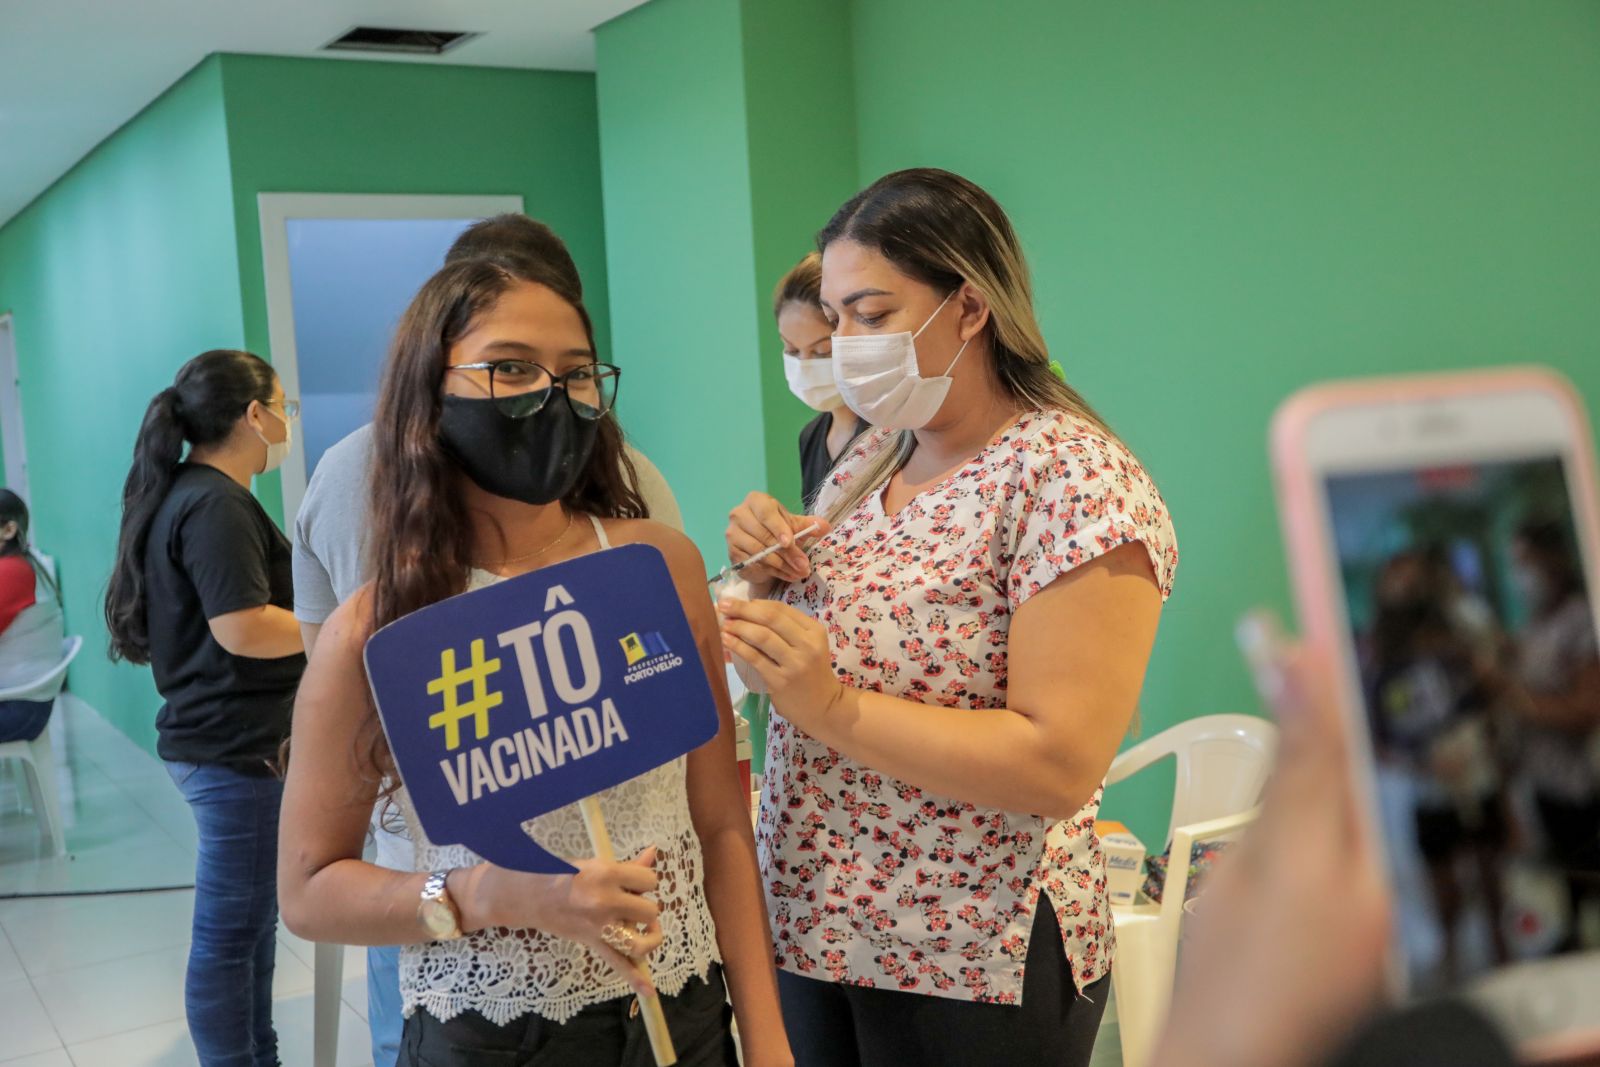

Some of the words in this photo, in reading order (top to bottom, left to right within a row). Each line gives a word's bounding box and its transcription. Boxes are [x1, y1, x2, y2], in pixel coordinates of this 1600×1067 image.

[427, 584, 601, 750] #TÔ
[624, 667, 654, 685] PORTO
[653, 656, 683, 673] VELHO
[628, 653, 674, 673] PREFEITURA
[440, 698, 629, 806] VACINADA
